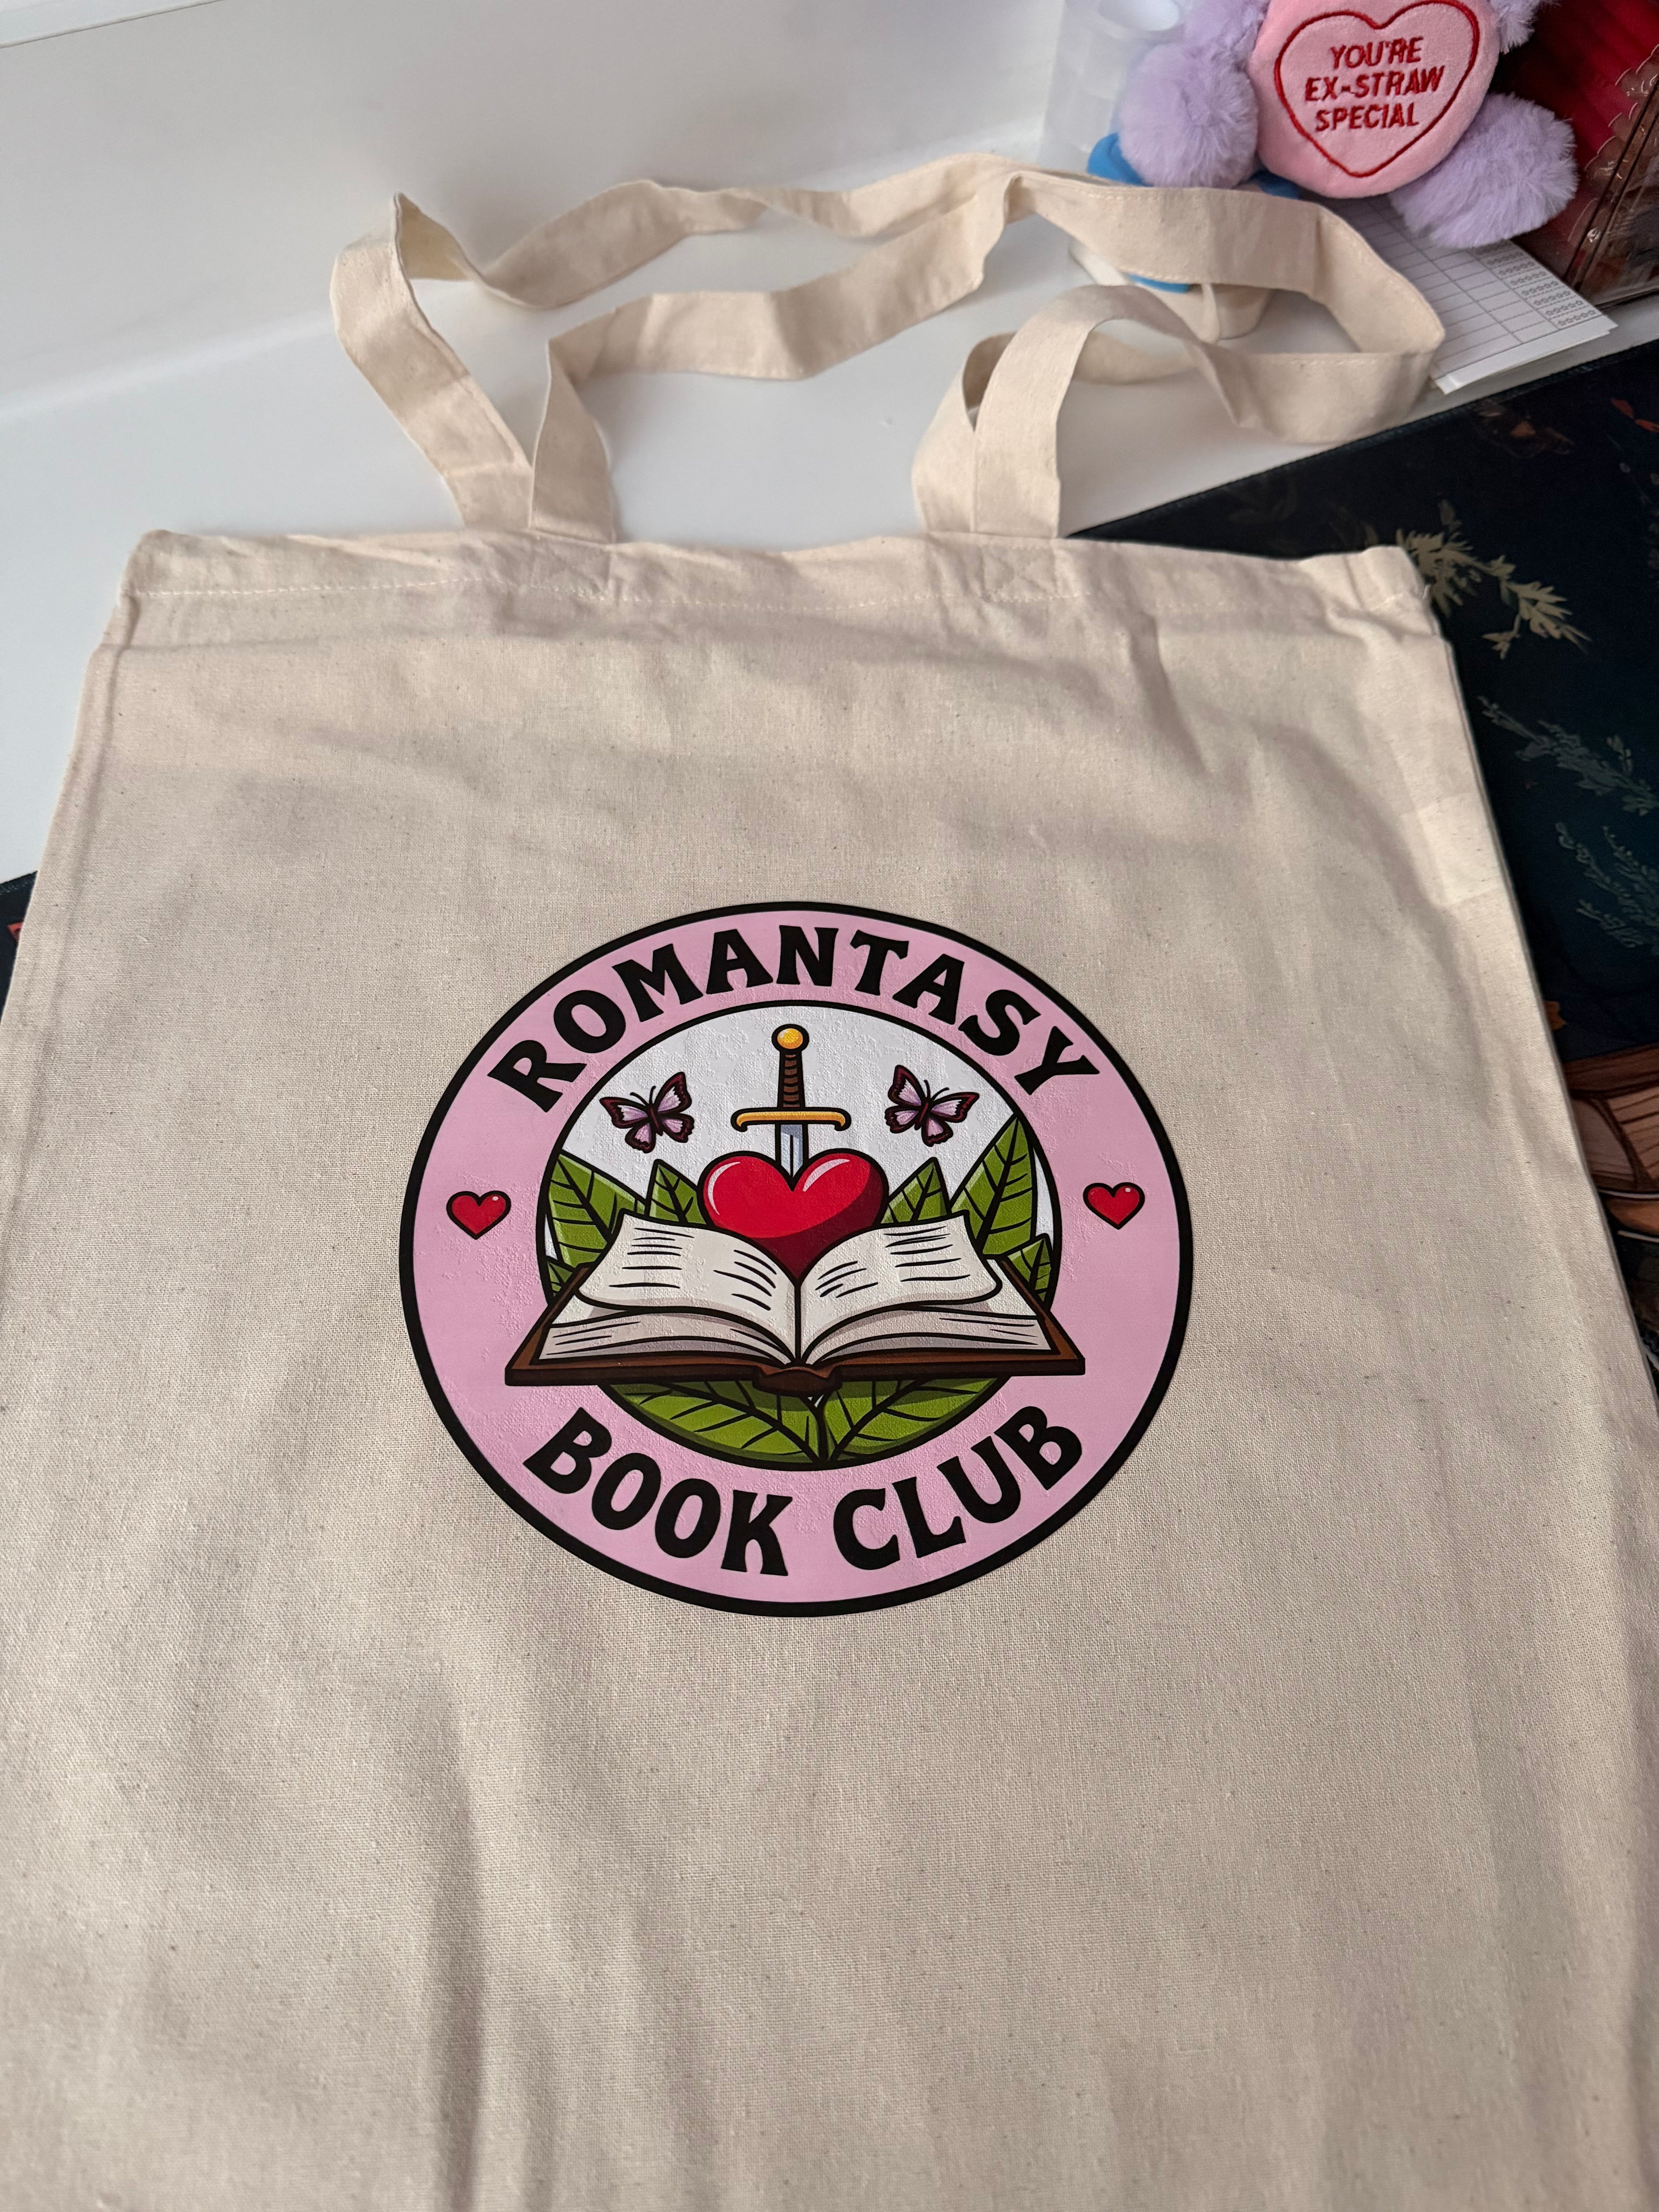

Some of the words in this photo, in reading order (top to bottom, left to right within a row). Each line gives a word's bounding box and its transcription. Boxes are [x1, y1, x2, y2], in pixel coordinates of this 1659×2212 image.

[1329, 36, 1424, 70] YOU'RE
[1305, 65, 1445, 102] EX-STRAW
[1315, 102, 1419, 131] SPECIAL
[487, 925, 1100, 1112] ROMANTASY
[523, 1407, 792, 1576] BOOK
[833, 1406, 1082, 1570] CLUB
